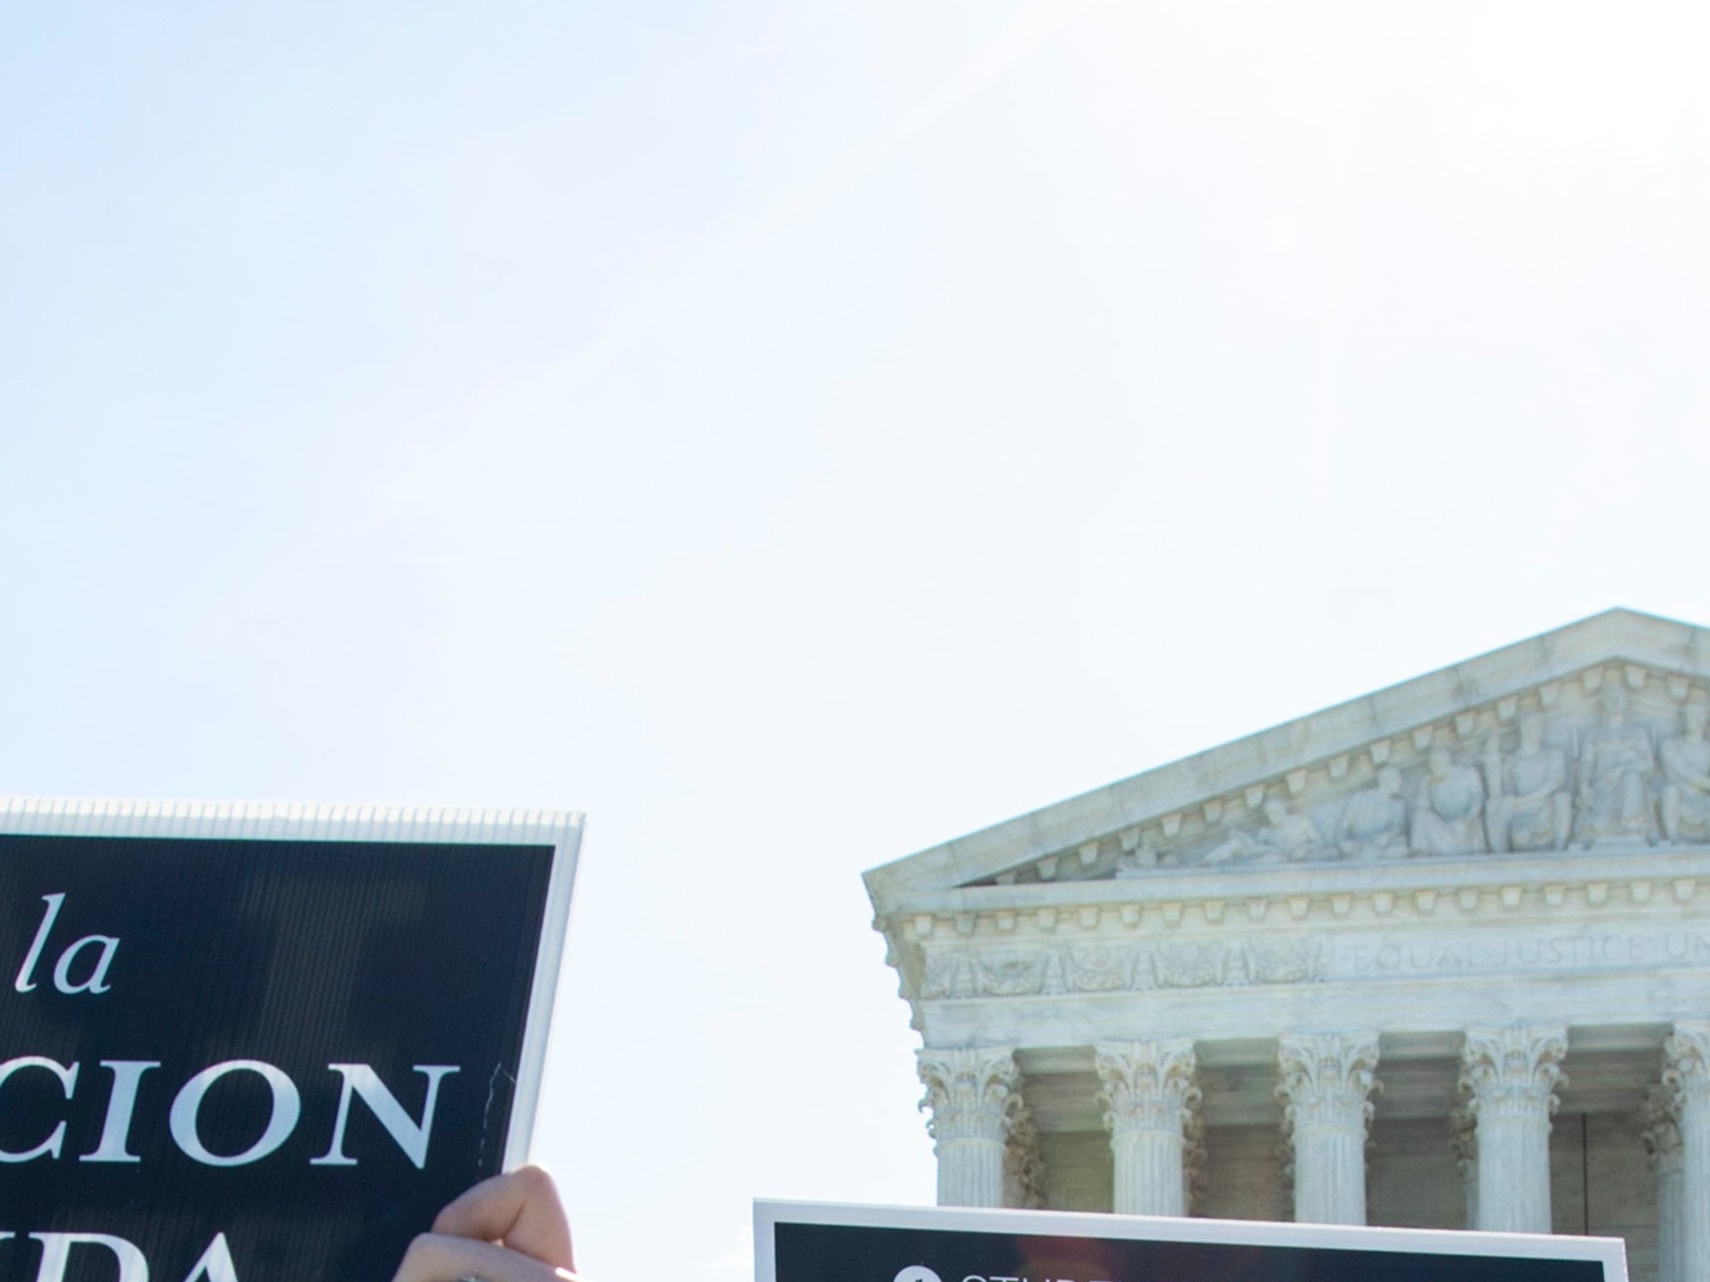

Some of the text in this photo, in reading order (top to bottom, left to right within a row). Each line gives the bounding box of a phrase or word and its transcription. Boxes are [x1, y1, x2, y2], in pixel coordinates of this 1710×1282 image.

[11, 891, 122, 997] la
[1354, 942, 1483, 972] EQUAL
[1494, 934, 1647, 967] JUSTICE
